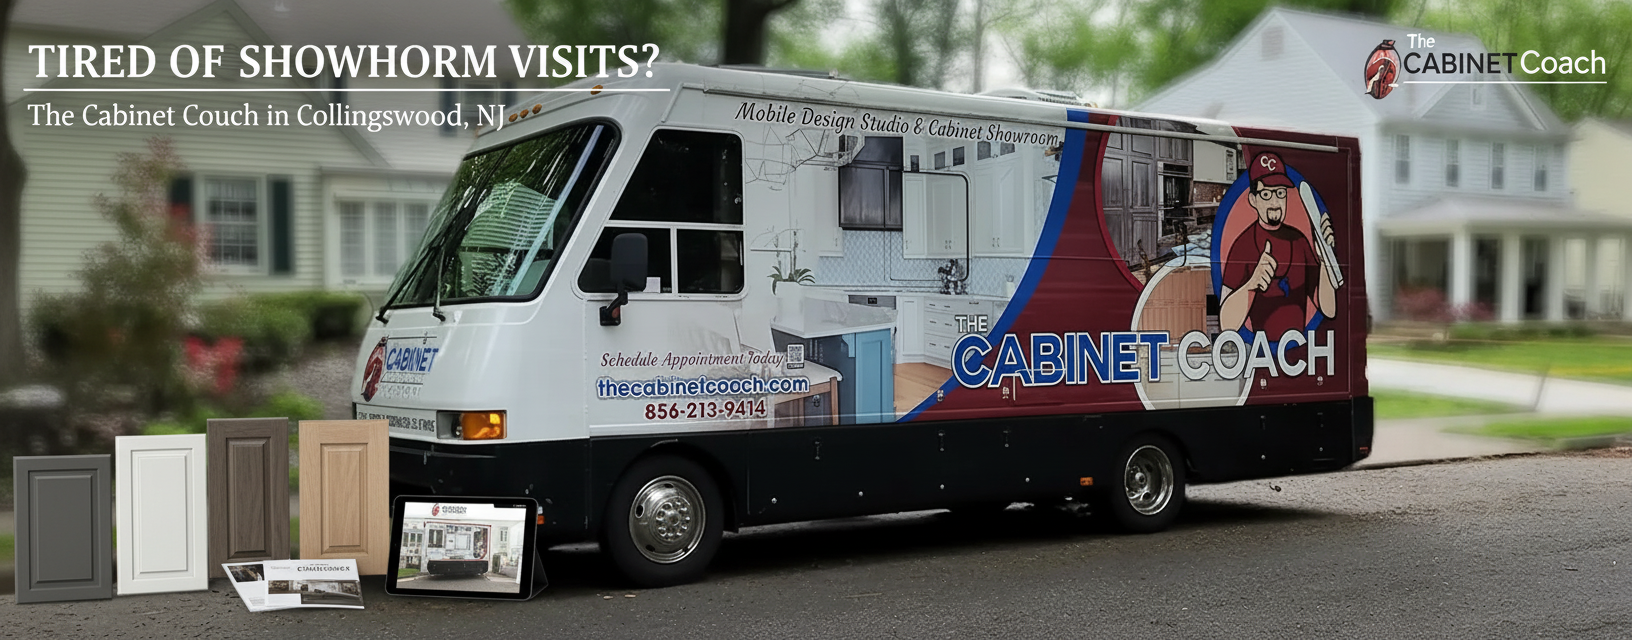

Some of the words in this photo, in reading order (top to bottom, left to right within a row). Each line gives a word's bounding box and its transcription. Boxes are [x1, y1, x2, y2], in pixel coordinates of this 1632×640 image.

[734, 101, 797, 124] Mobile
[801, 106, 855, 134] Design
[860, 112, 909, 134] Studio
[913, 117, 924, 135] &
[928, 119, 983, 140] Cabinet
[954, 314, 988, 333] THE
[600, 352, 658, 367] Schedule
[661, 350, 744, 370] Appointment
[950, 330, 1170, 389] CABINET
[1176, 329, 1335, 380] COACH
[644, 400, 767, 420] 856-213-9414
